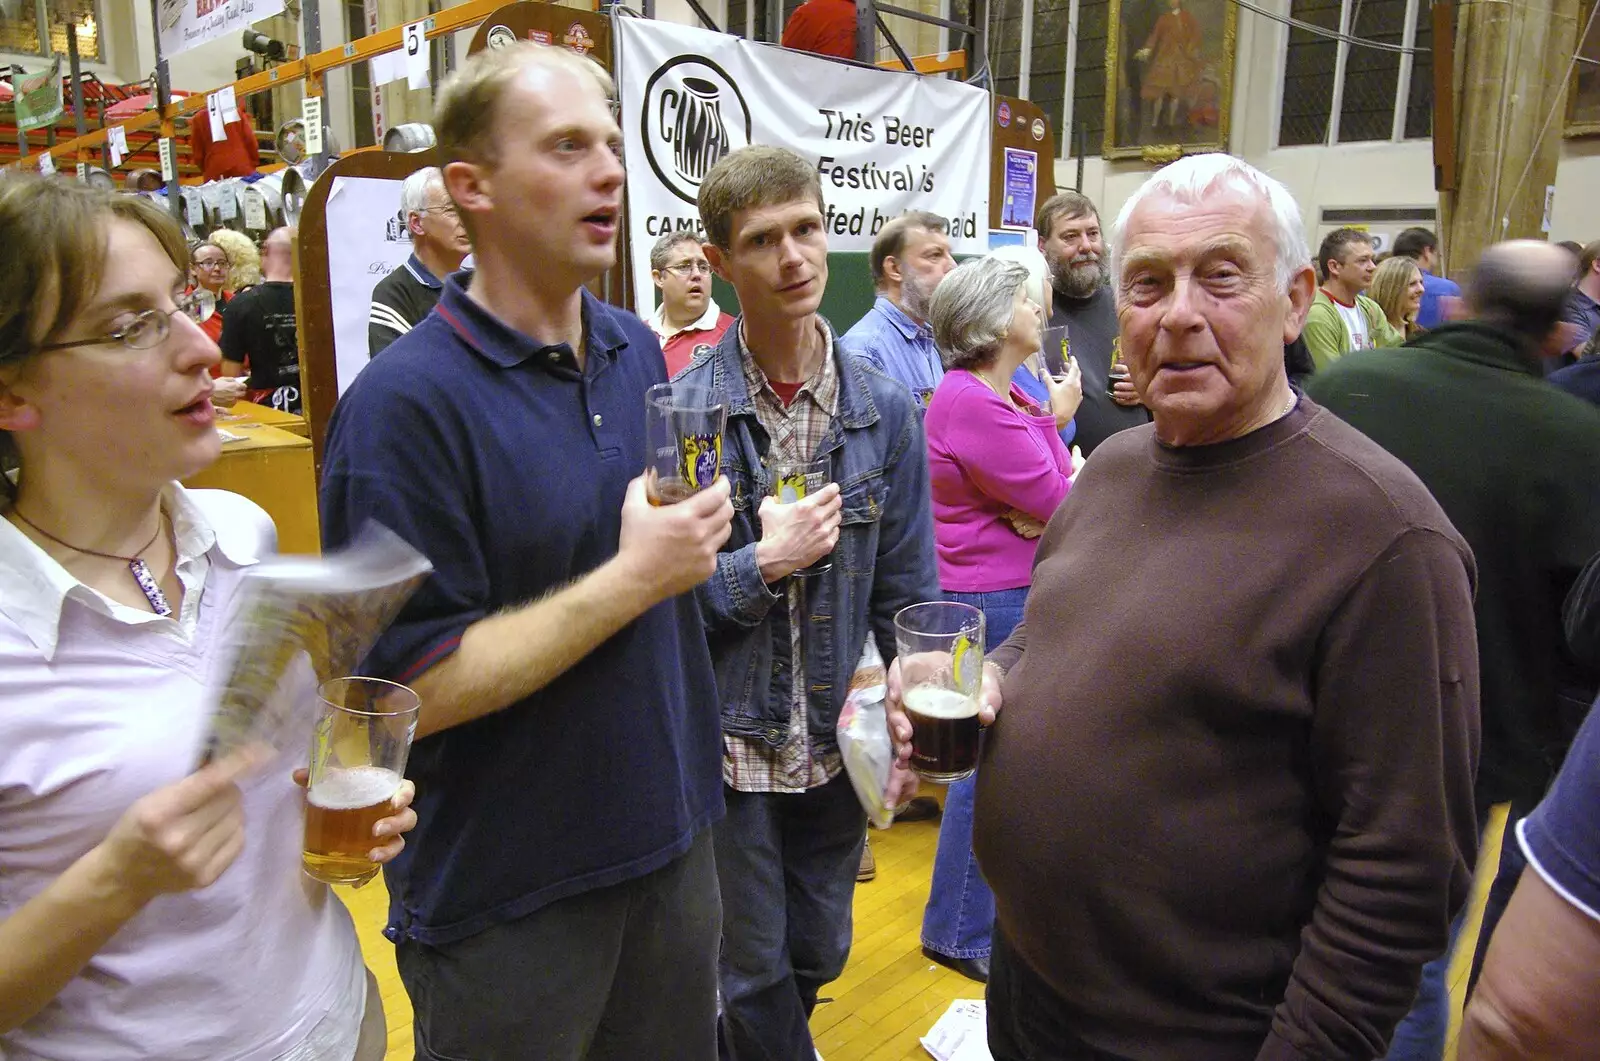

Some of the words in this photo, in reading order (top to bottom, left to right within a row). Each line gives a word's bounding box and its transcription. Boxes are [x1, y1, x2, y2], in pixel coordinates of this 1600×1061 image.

[408, 25, 418, 56] 5
[818, 108, 876, 143] This
[883, 115, 934, 148] Beer
[817, 156, 914, 192] Festival
[917, 164, 935, 193] is
[826, 203, 865, 236] fed
[367, 261, 394, 275] Pri
[703, 449, 716, 467] 30
